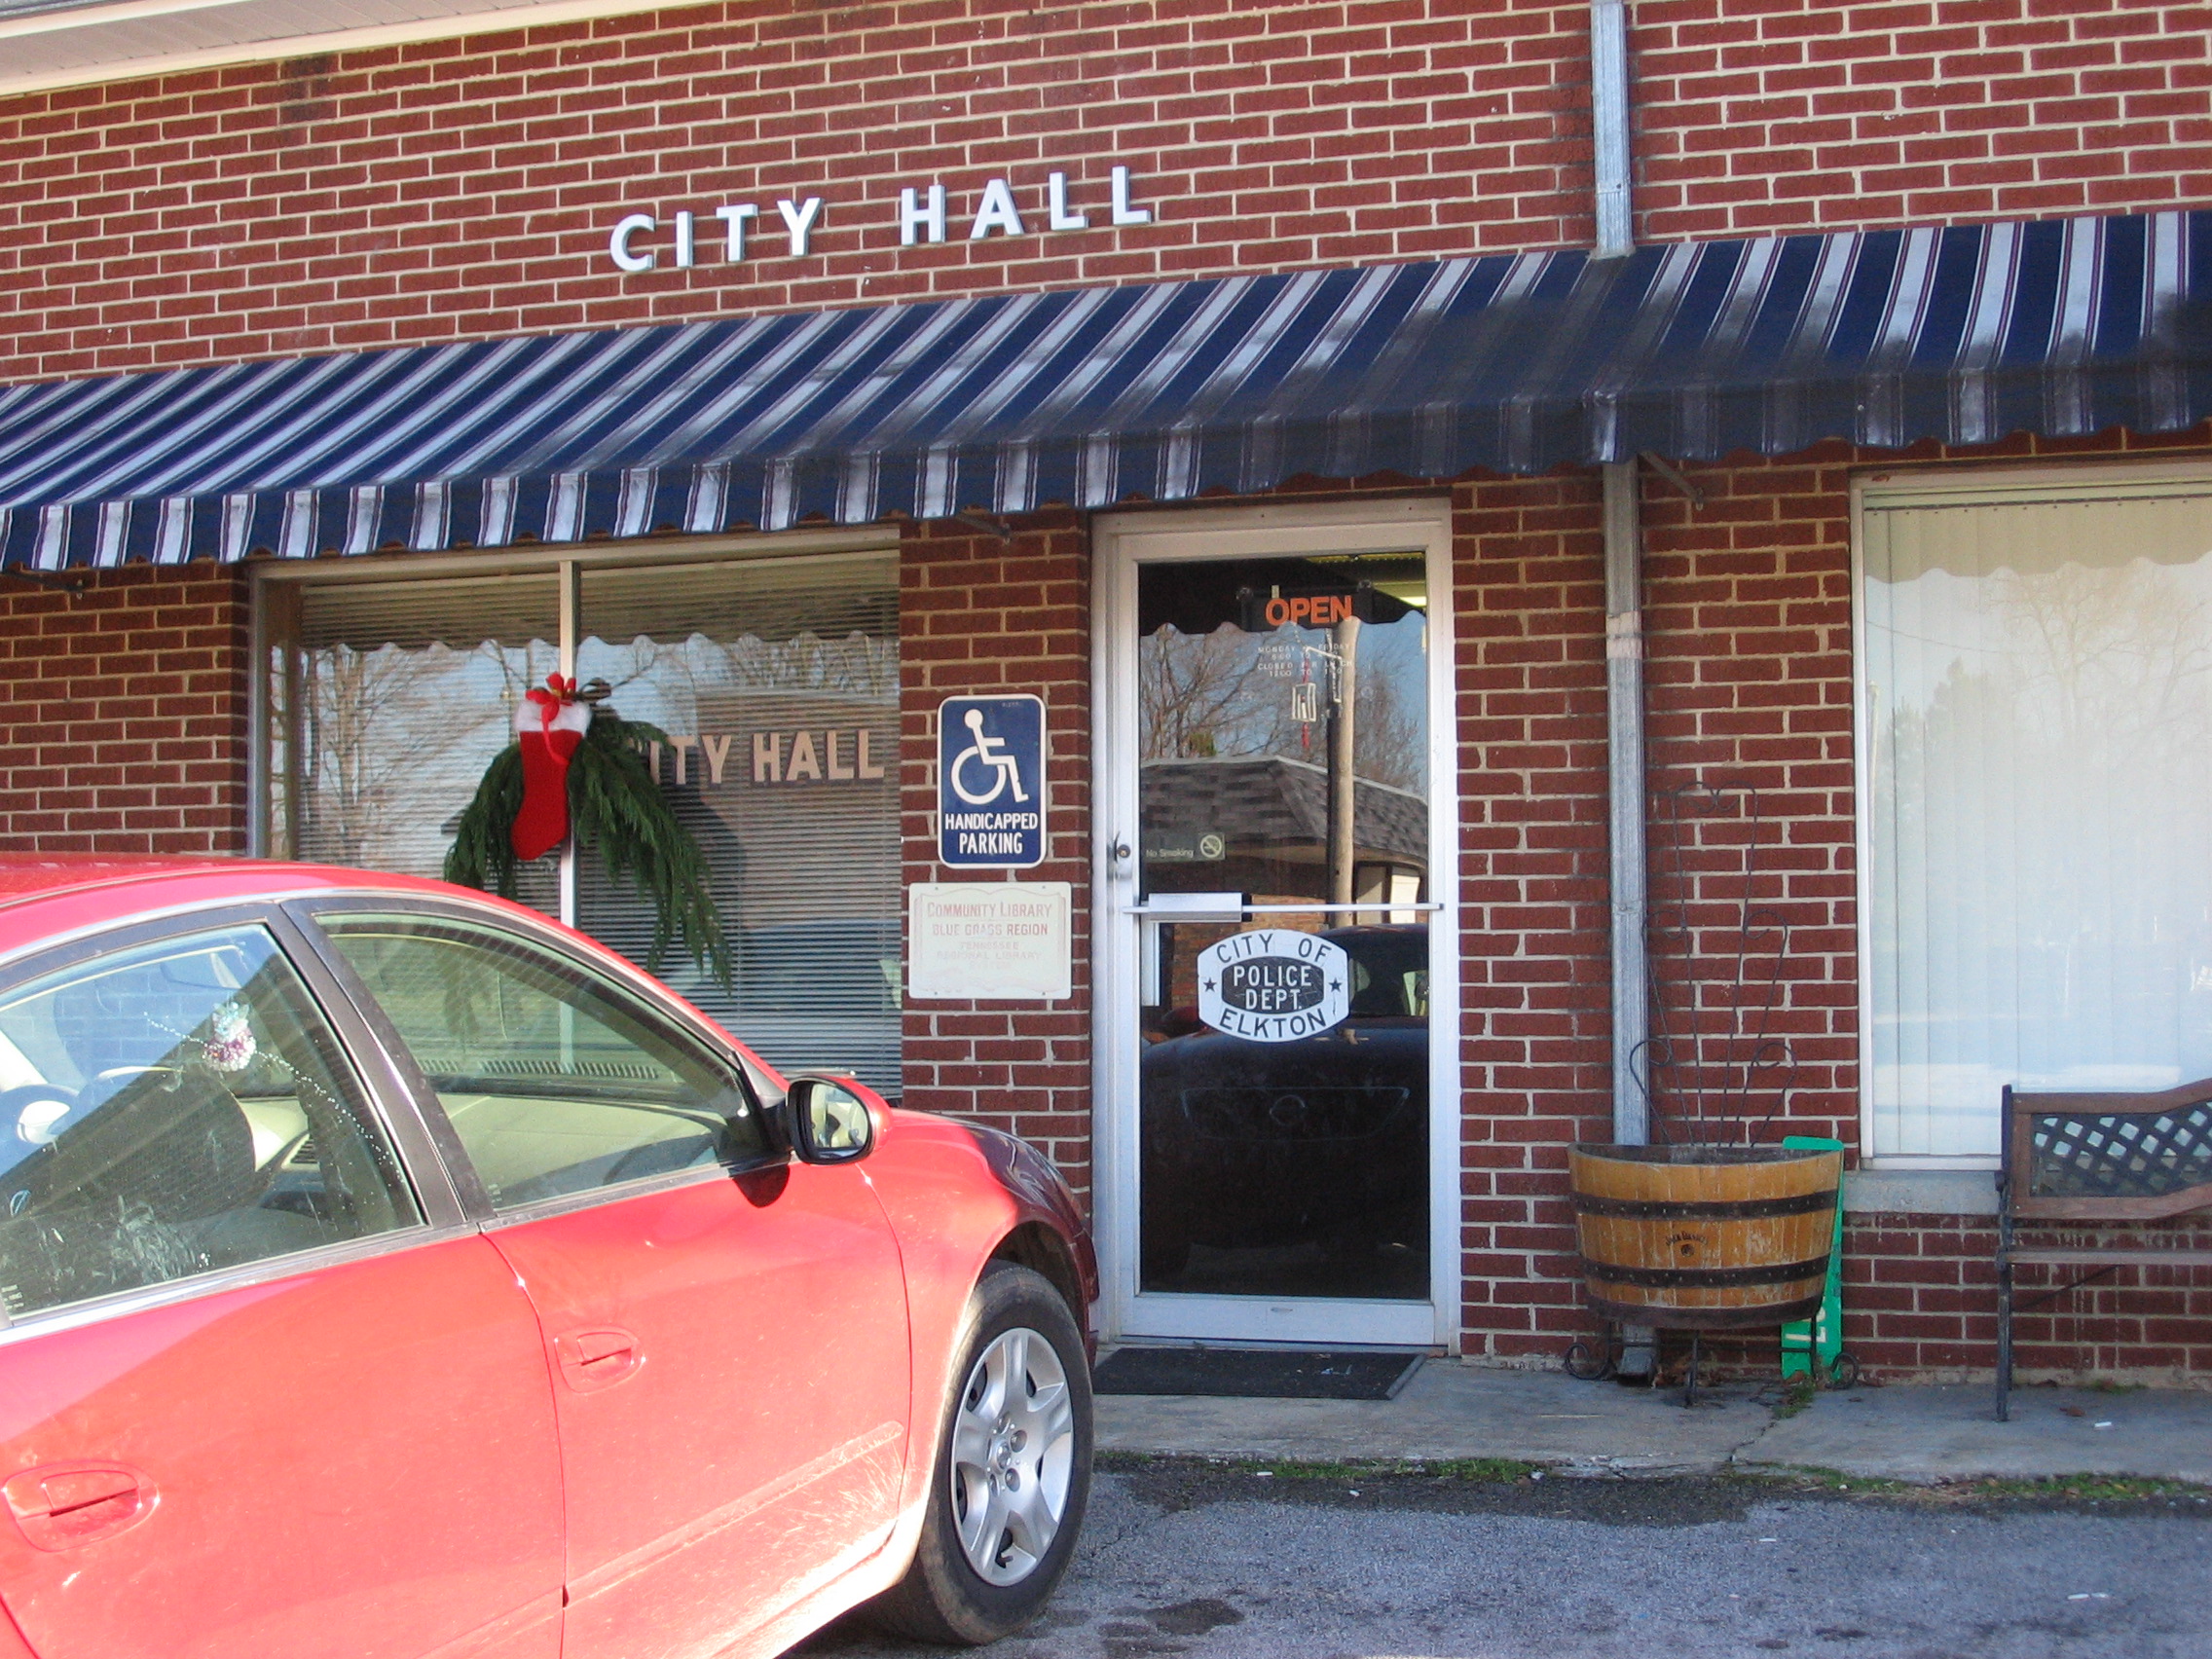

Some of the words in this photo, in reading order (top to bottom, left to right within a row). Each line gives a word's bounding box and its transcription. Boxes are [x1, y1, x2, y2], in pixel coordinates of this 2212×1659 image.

[608, 196, 825, 273] CITY
[900, 165, 1152, 246] HALL
[1265, 595, 1352, 627] OPEN
[1257, 662, 1293, 671] CLOSED
[646, 733, 732, 786] ITY
[752, 729, 885, 783] HALL
[944, 812, 1038, 830] HANDICAPPED
[958, 831, 1023, 854] PARKING
[1160, 848, 1195, 859] Smoking
[927, 902, 997, 918] COMMUNITY
[1000, 901, 1052, 918] LIBRARY
[933, 923, 960, 936] BLUE
[964, 923, 1003, 936] GRASS
[1006, 923, 1050, 936] REGION
[1216, 933, 1273, 964] CITY
[1298, 938, 1333, 963] OF
[1233, 965, 1313, 987] POLICE
[1244, 989, 1304, 1011] DEPT.
[1219, 1008, 1327, 1038] ELKTON
